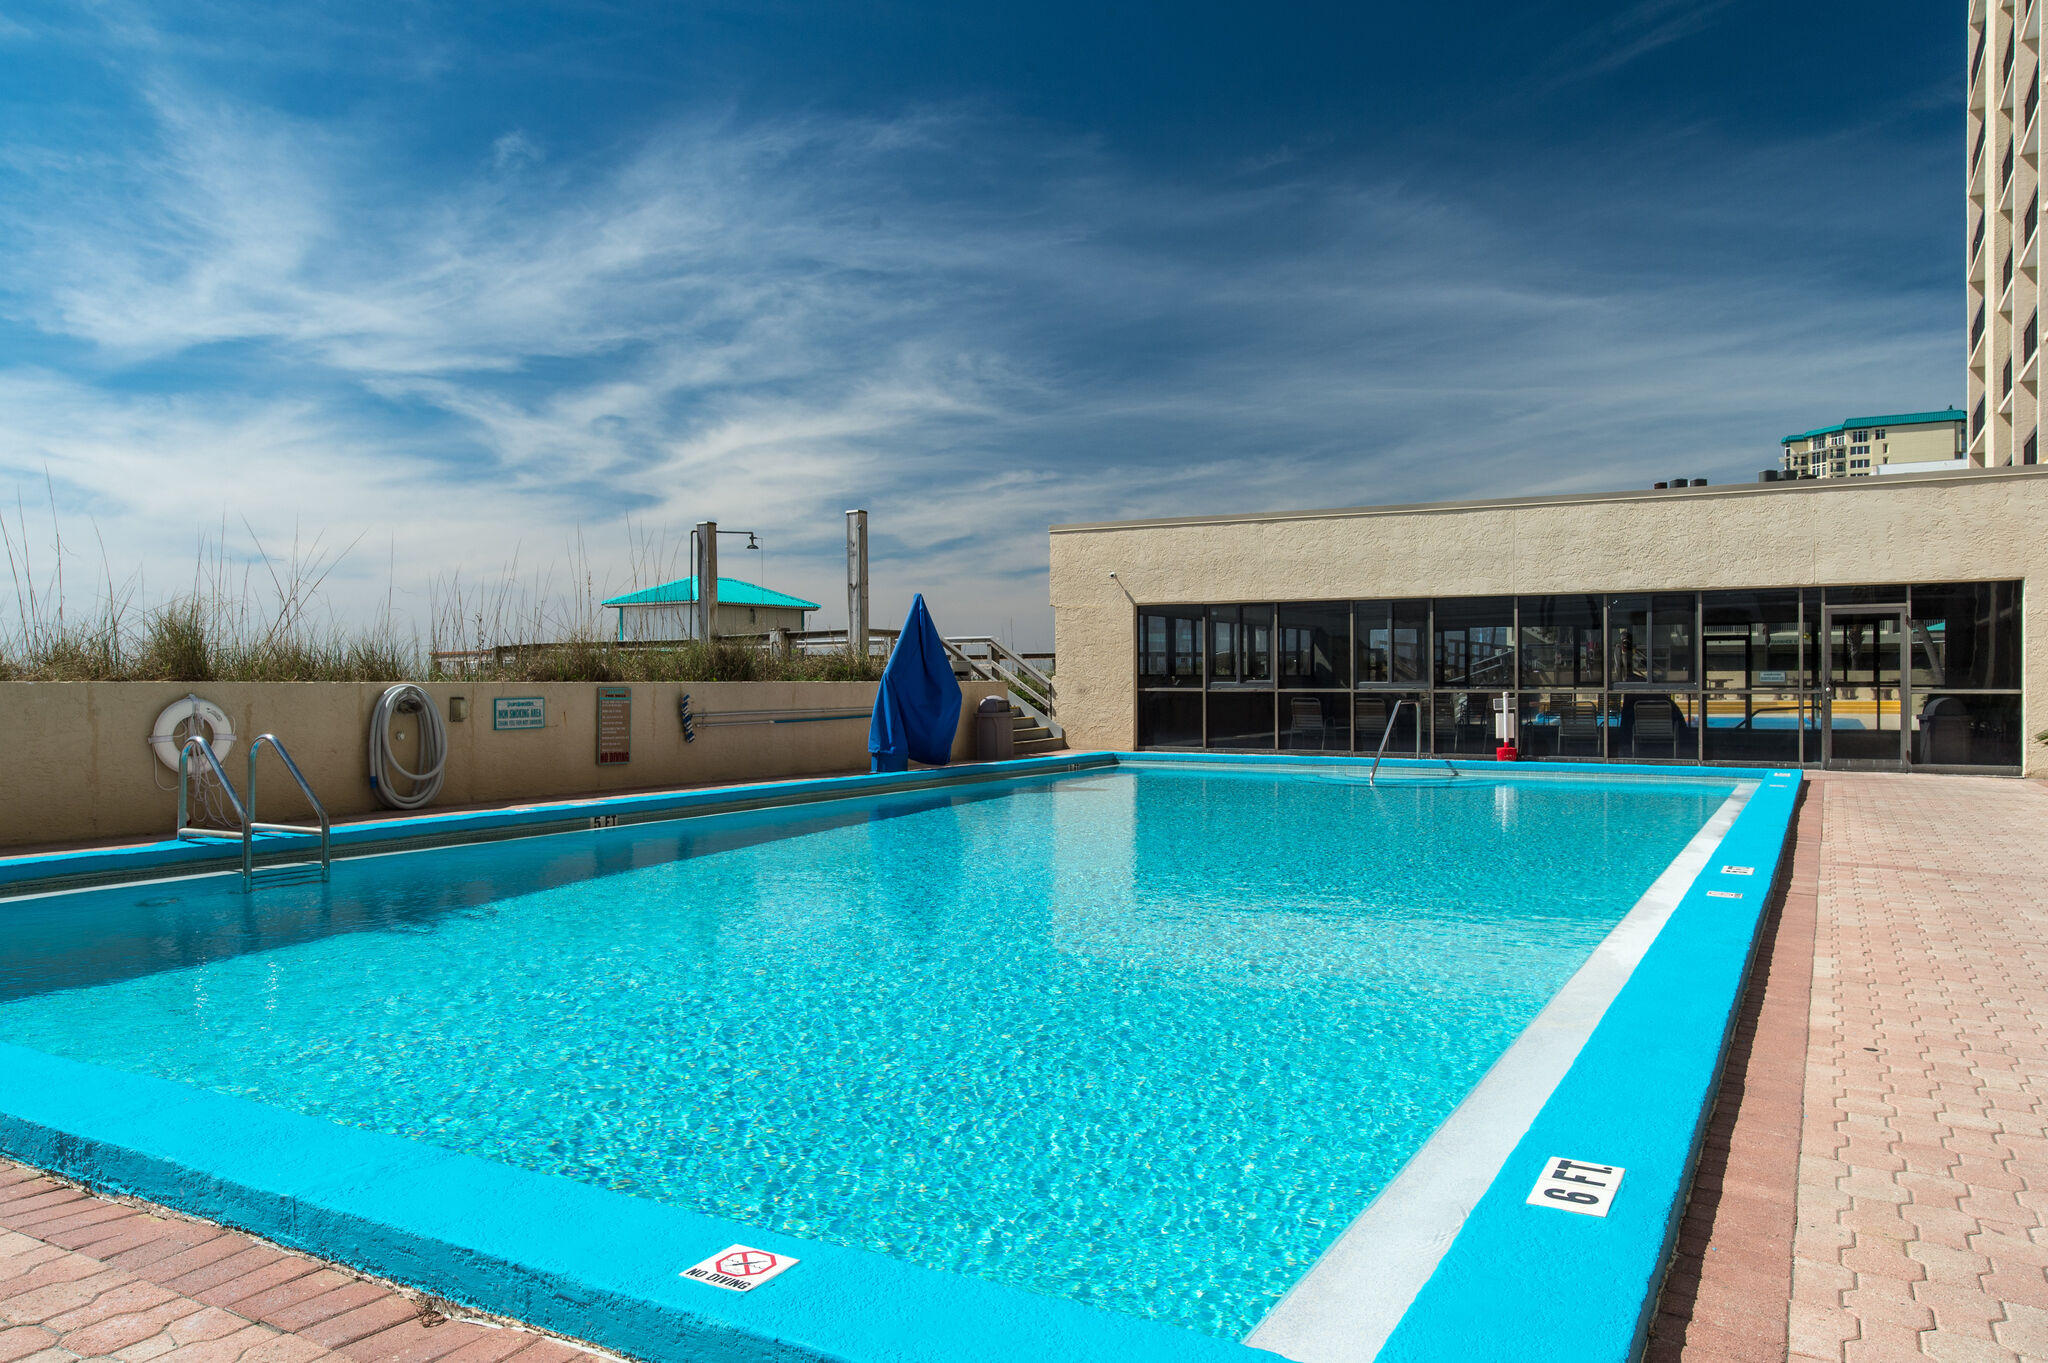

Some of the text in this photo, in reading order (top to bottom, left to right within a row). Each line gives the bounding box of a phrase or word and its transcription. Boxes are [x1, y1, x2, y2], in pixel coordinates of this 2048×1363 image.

[509, 708, 530, 718] SMOKING
[530, 708, 542, 718] AREA
[600, 752, 630, 763] NO DIVING
[594, 814, 617, 828] 5 FT
[1543, 1188, 1600, 1205] 6
[685, 1268, 752, 1290] NO DIVING
